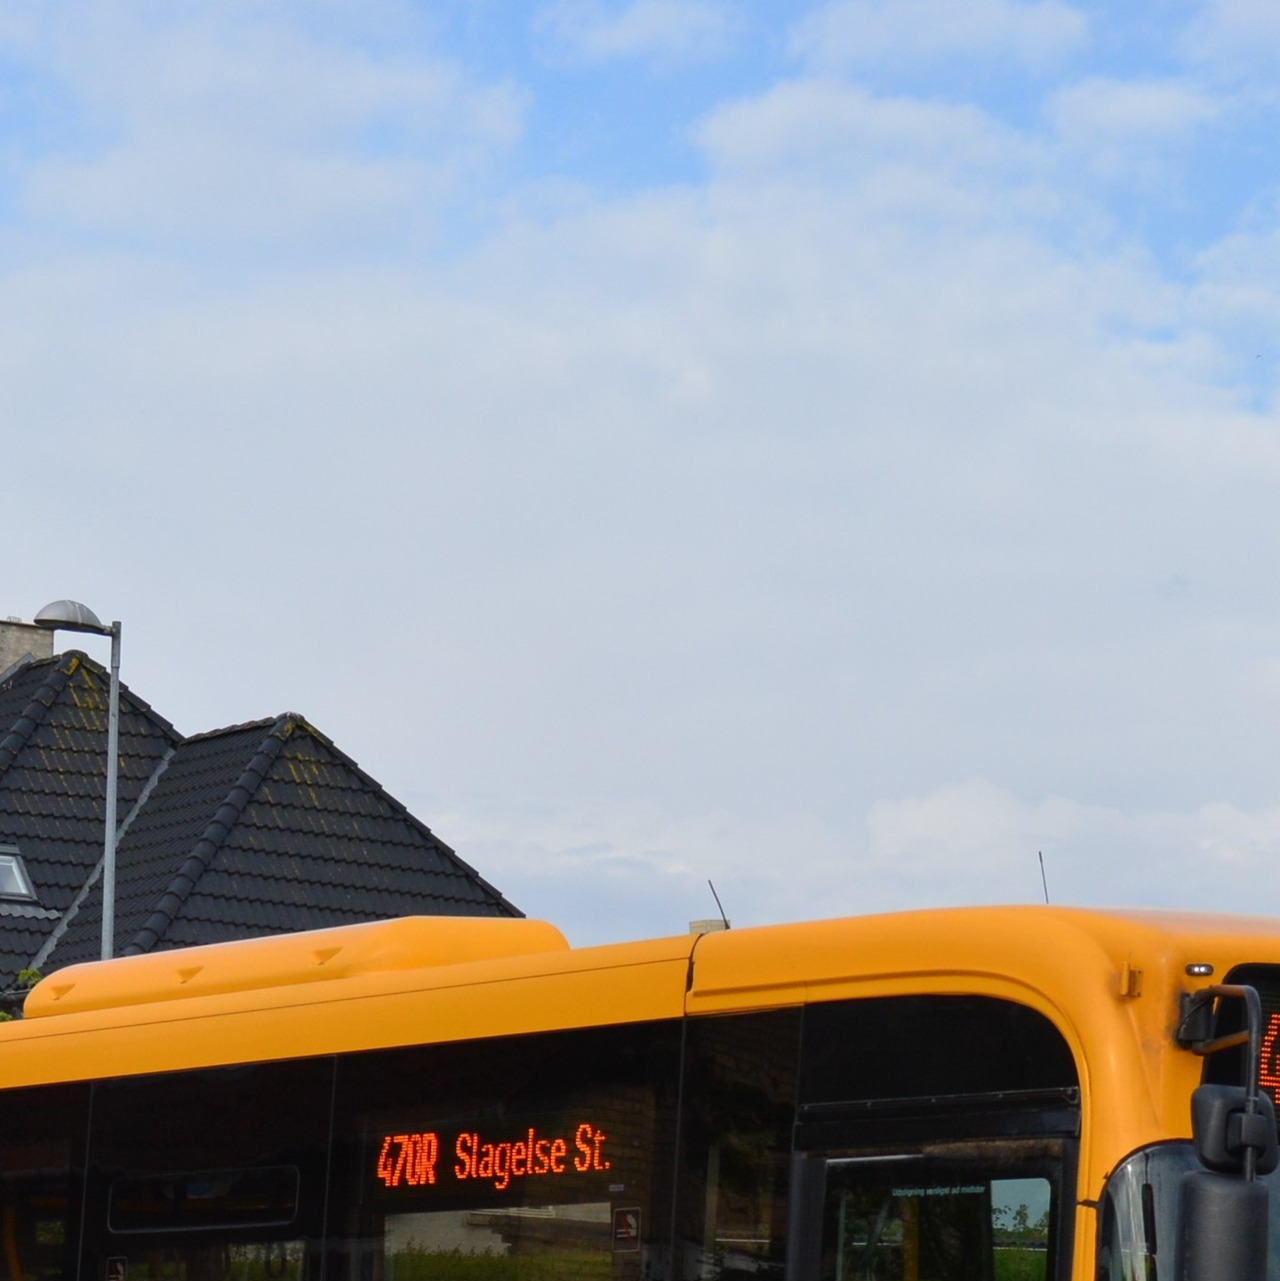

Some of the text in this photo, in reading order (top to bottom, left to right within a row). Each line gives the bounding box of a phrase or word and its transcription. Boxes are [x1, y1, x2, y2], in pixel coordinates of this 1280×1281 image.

[377, 1123, 611, 1189] 470R Slagelse St.
